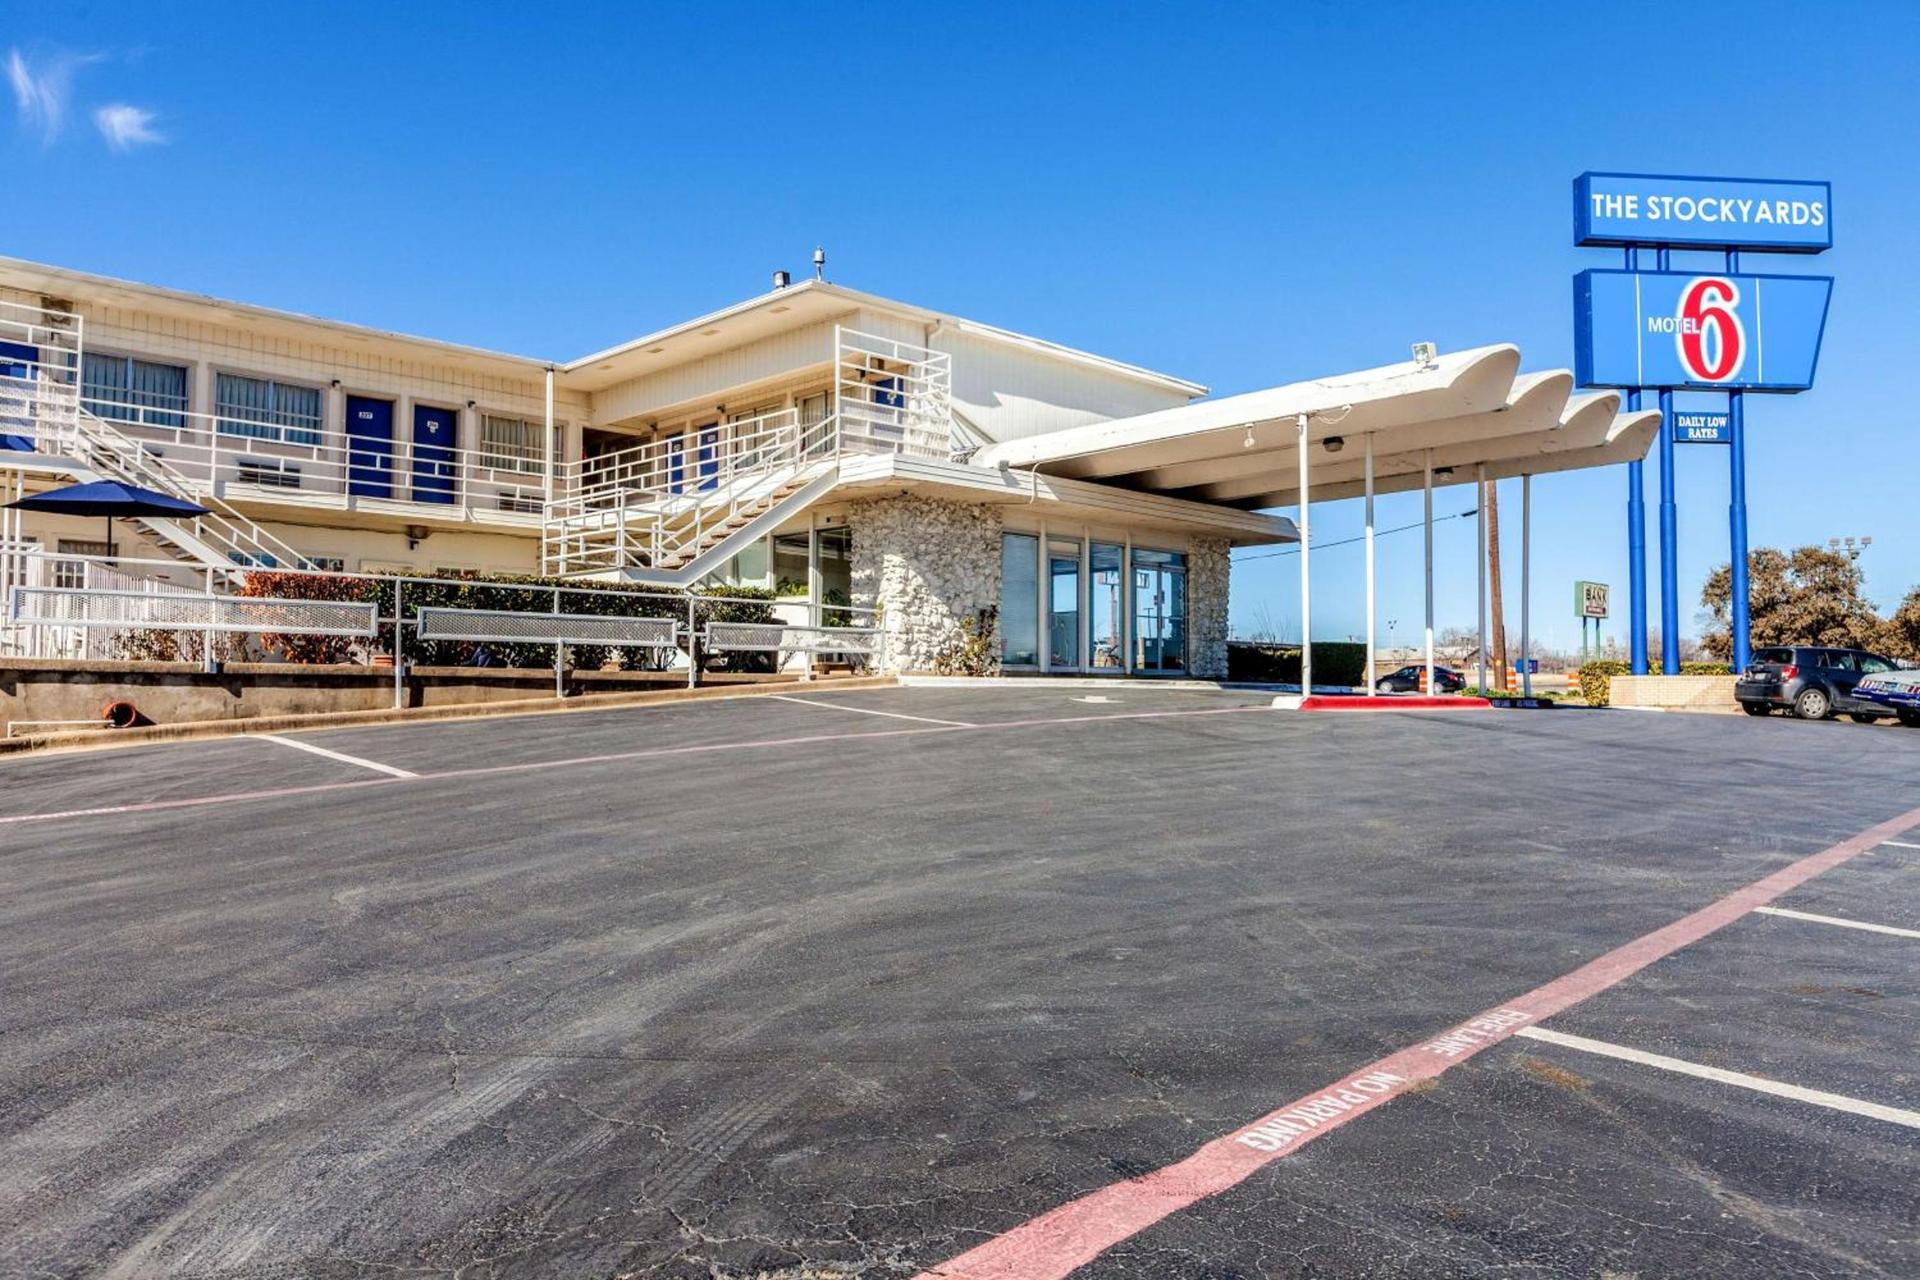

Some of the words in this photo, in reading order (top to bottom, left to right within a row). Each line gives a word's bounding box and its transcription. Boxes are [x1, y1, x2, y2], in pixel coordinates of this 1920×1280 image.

[1591, 193, 1639, 219] THE
[1646, 196, 1825, 226] STOCKYARDS
[1647, 316, 1701, 335] MOTEL
[1676, 277, 1746, 383] 6
[1678, 415, 1706, 428] DAILY
[1707, 415, 1728, 428] LOW
[1688, 427, 1719, 439] RATES
[1351, 1071, 1407, 1092] NO
[1236, 1088, 1371, 1151] PARKING
